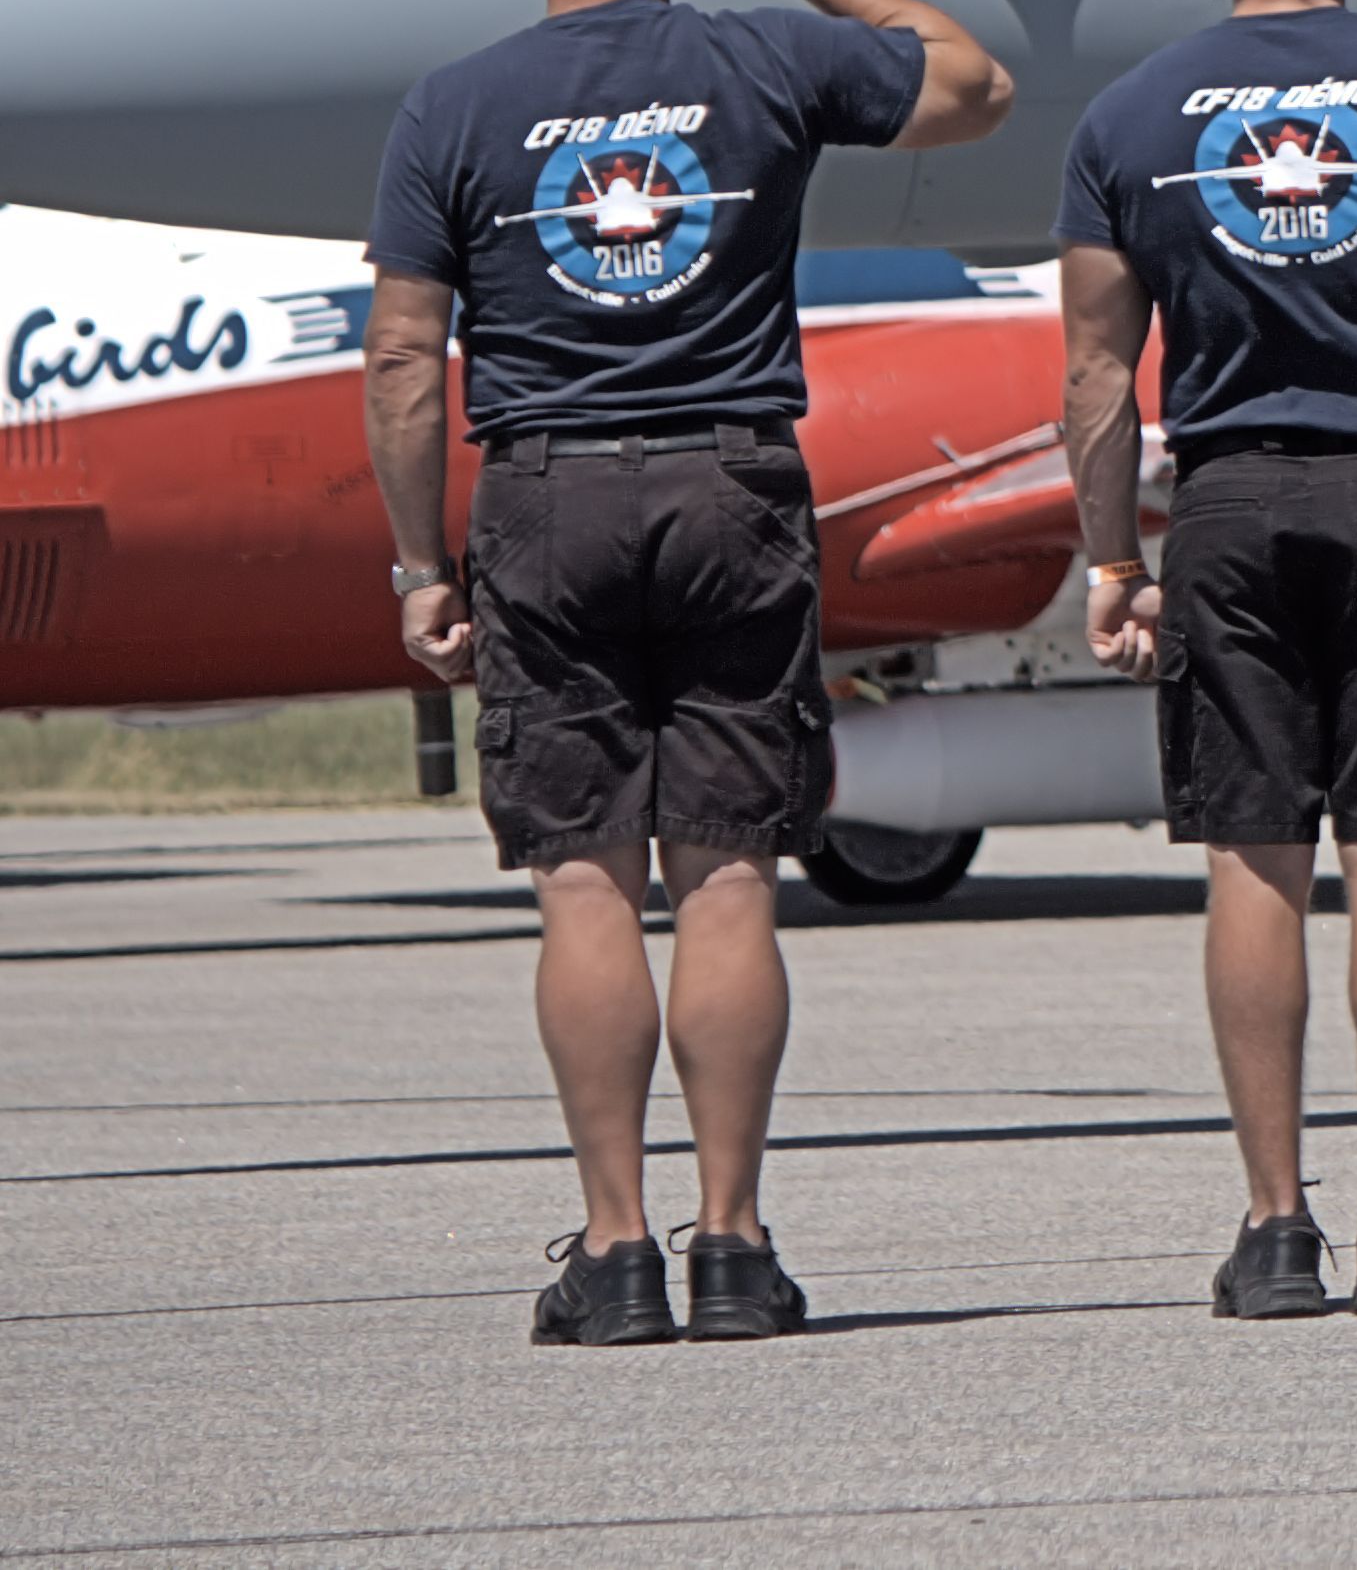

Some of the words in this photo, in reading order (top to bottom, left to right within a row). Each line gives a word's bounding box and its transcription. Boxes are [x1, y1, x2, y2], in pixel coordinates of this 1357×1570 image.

[1181, 86, 1276, 115] CF18
[523, 116, 608, 150] CF18
[608, 101, 708, 142] DÉMO
[1258, 205, 1329, 243] 2016
[593, 240, 664, 280] 2016
[1311, 244, 1346, 265] Cold
